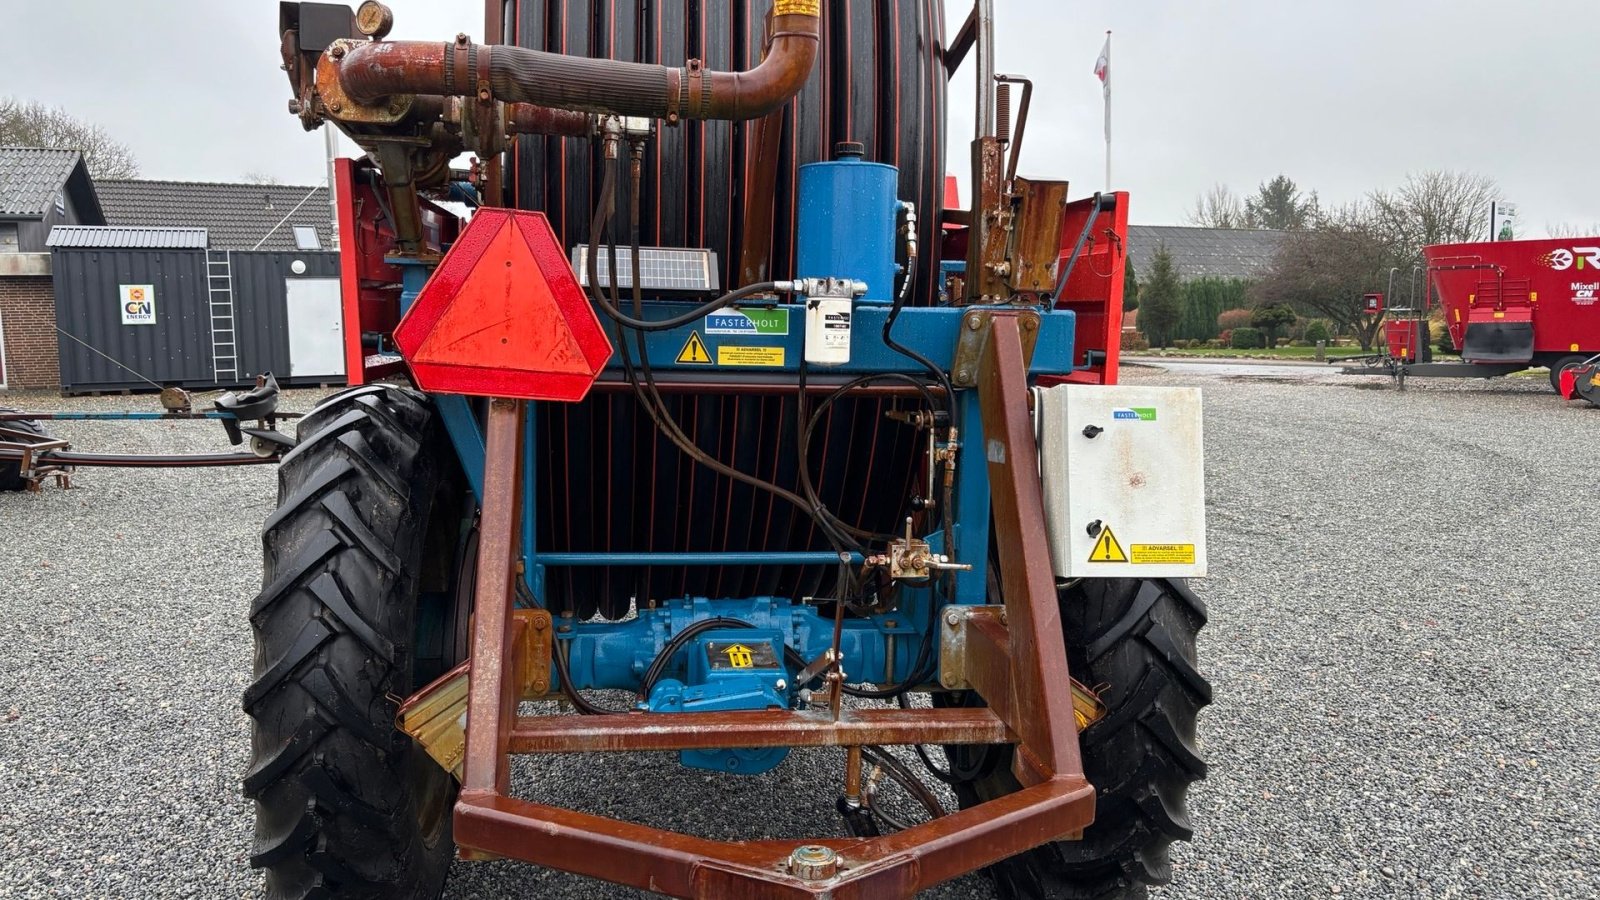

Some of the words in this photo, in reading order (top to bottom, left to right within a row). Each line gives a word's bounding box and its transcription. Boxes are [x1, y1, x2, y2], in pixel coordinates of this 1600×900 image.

[1571, 282, 1600, 290] Mixell
[125, 302, 151, 314] CN
[715, 318, 779, 328] FASTERHOLT
